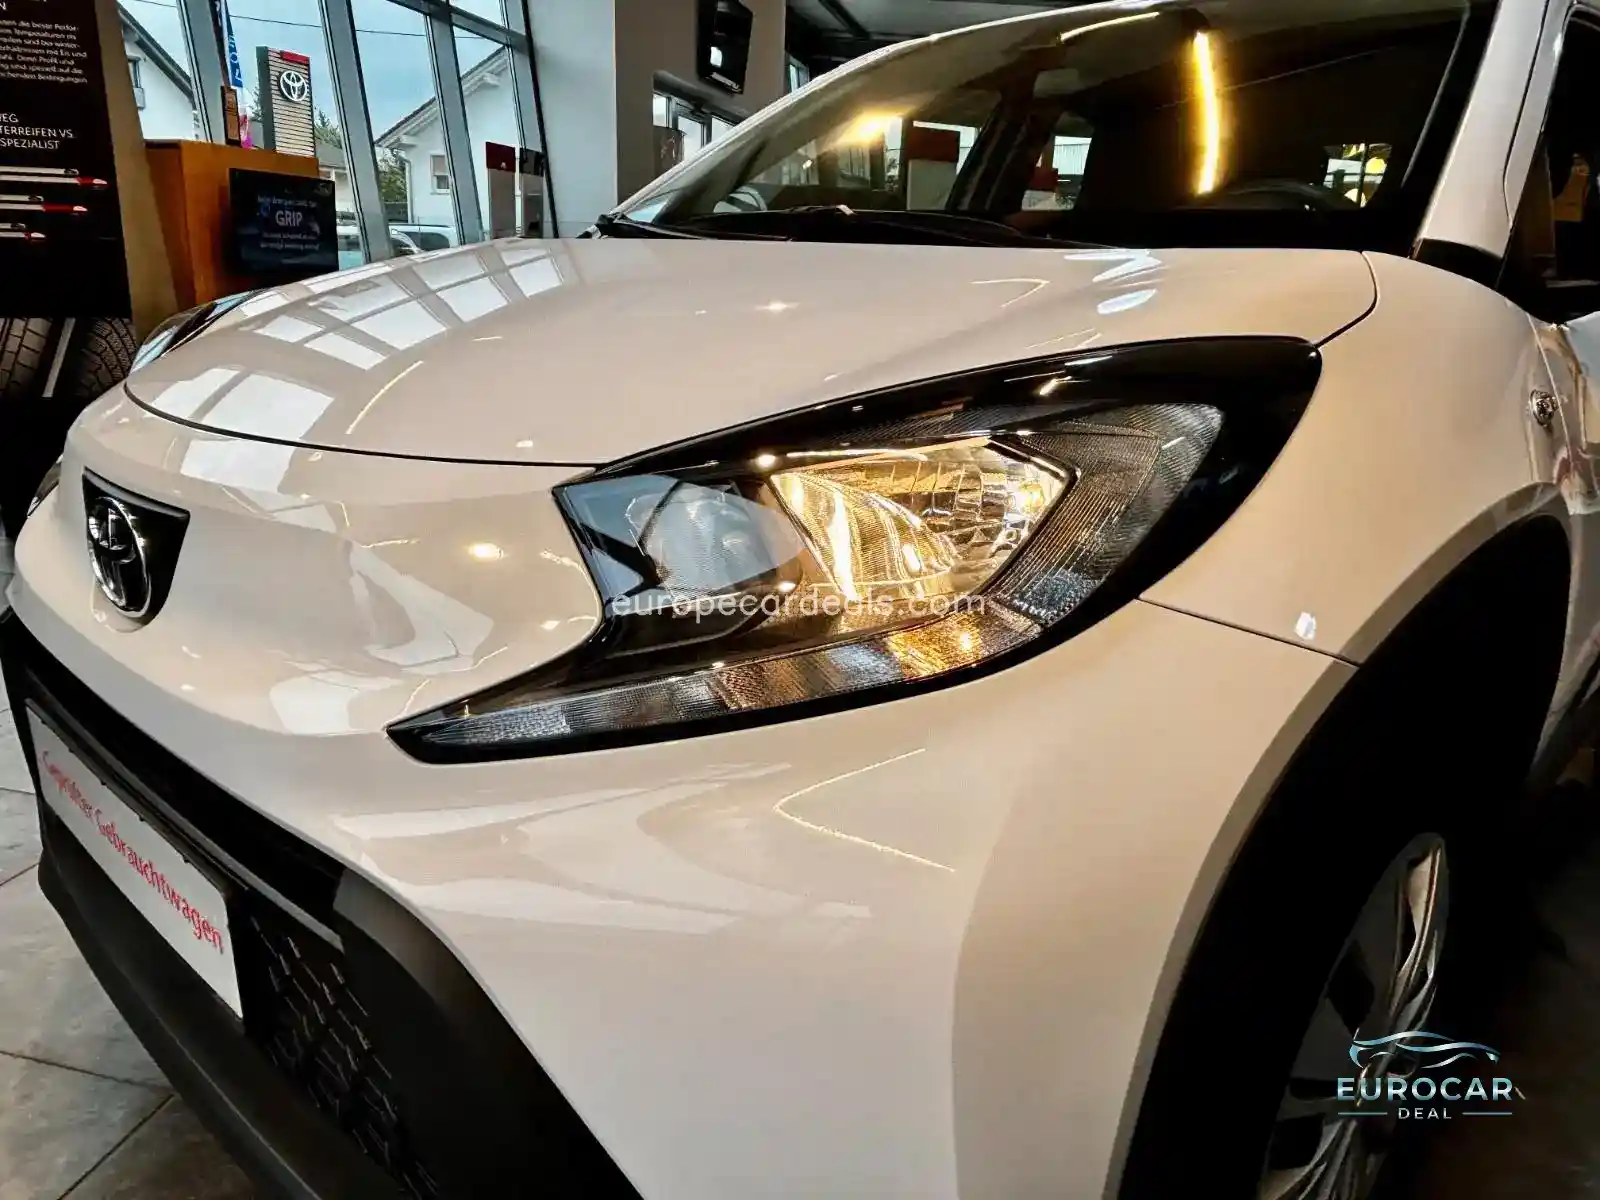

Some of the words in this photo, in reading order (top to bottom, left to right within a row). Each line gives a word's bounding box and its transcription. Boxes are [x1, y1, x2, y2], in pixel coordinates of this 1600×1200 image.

[0, 138, 60, 149] SPEZIALIST
[275, 210, 303, 228] GRIP
[94, 808, 224, 955] Gebrauchtwagen
